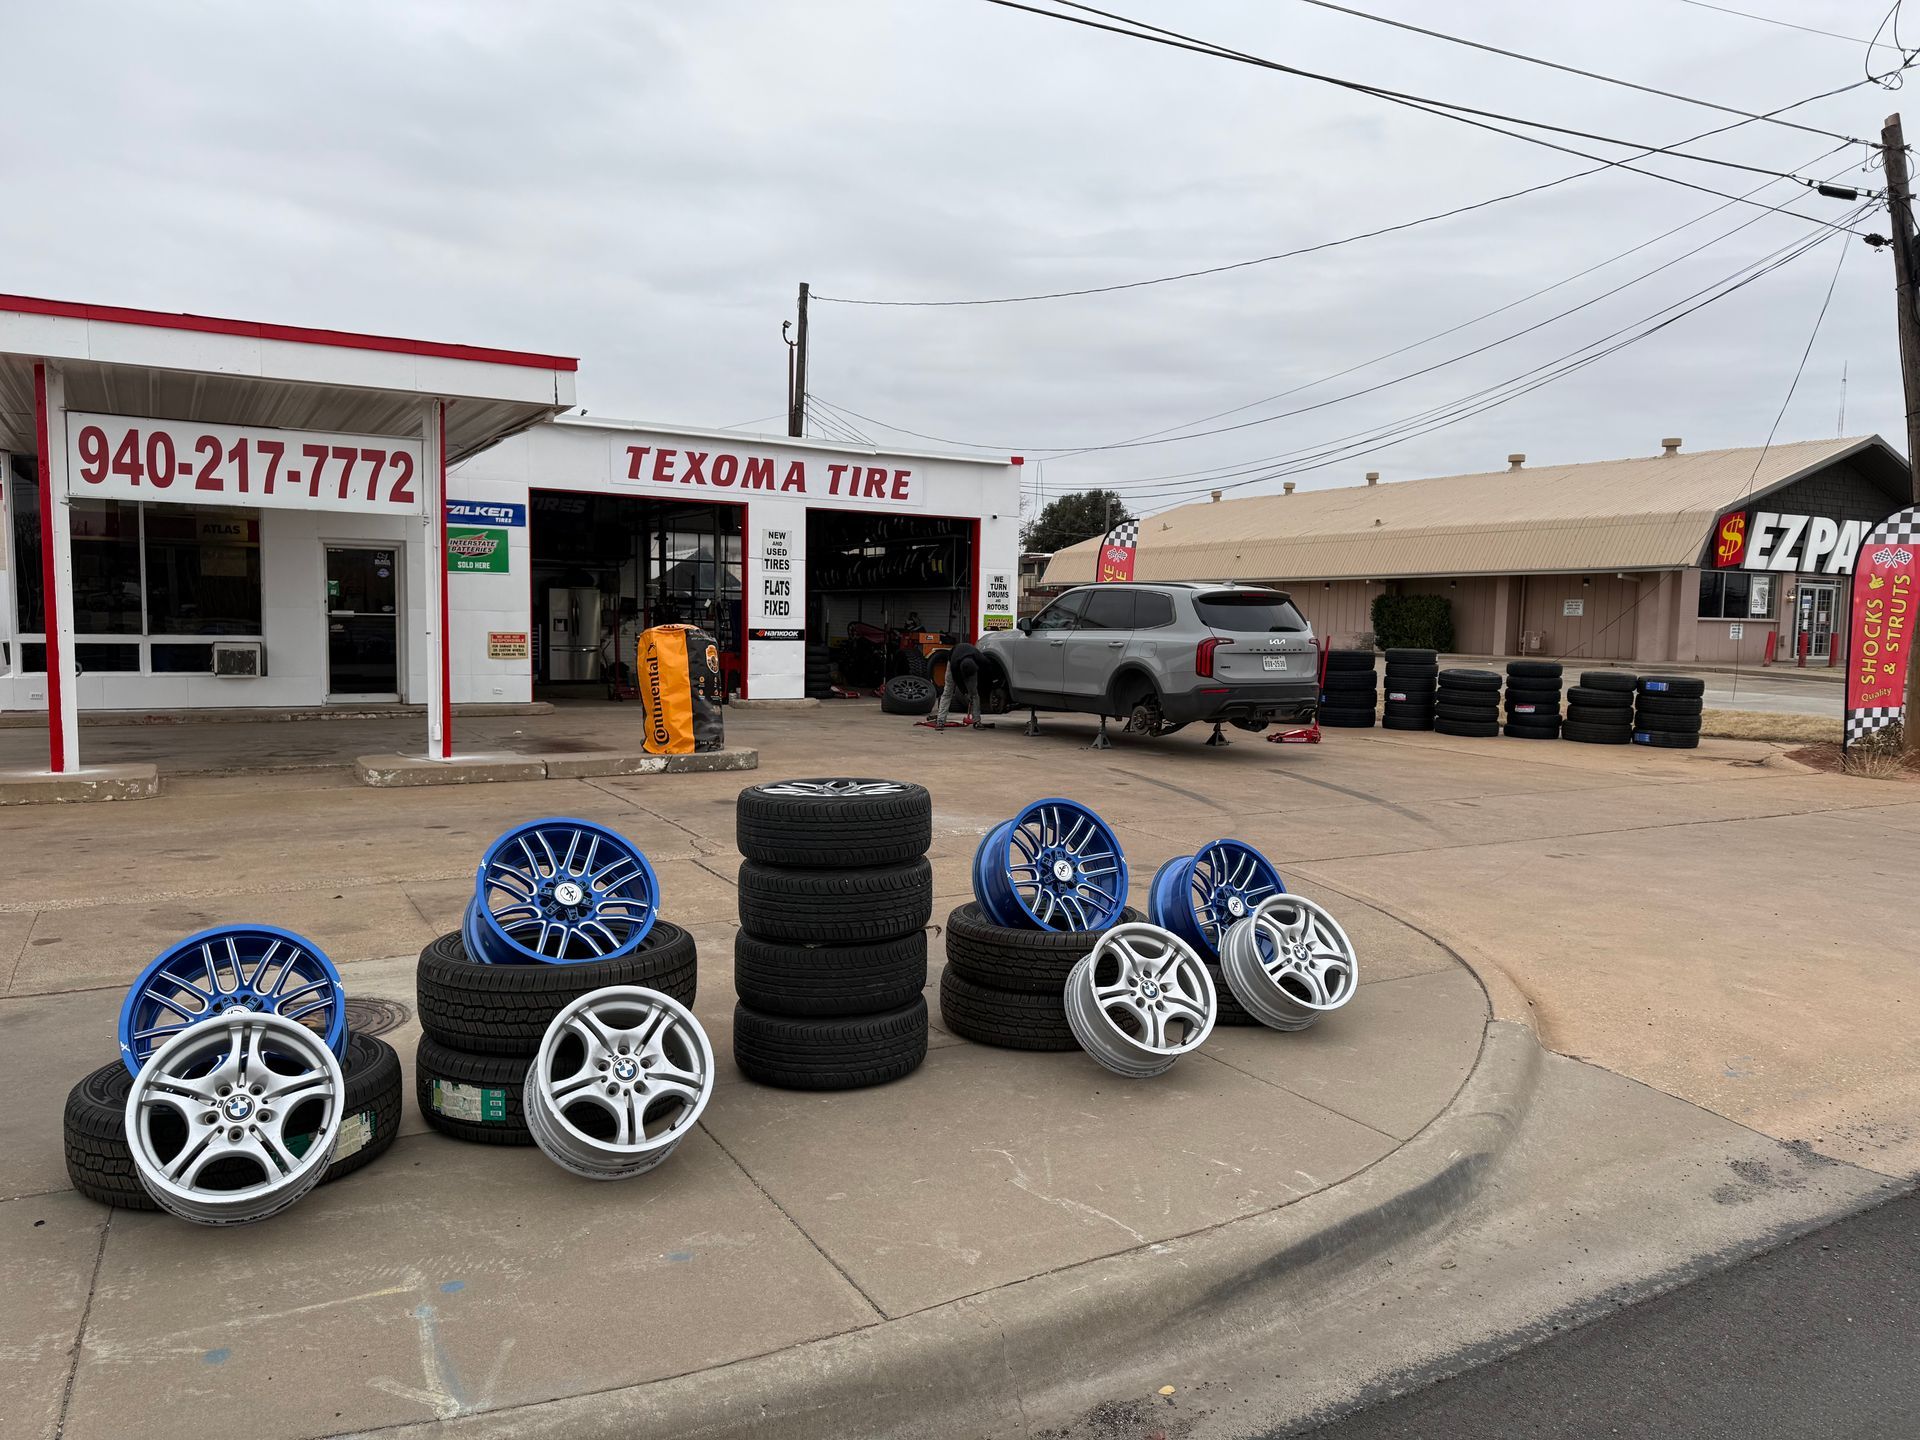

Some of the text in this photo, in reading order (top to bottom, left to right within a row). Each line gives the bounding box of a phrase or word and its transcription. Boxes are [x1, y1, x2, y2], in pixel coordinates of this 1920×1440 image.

[78, 425, 414, 503] 940-217-7772
[626, 445, 911, 500] TEXOMA TIRE
[202, 523, 241, 535] ATLAS
[768, 531, 786, 540] NEW
[766, 548, 788, 556] USED
[764, 559, 790, 570] TIRES
[764, 580, 790, 596] FLATS
[987, 591, 1010, 599] DRUMS
[764, 600, 790, 616] FIXED
[1883, 574, 1911, 675] & STRUTS
[1861, 598, 1884, 685] SHOCKS
[646, 656, 671, 746] Continental
[1861, 687, 1893, 702] Quality
